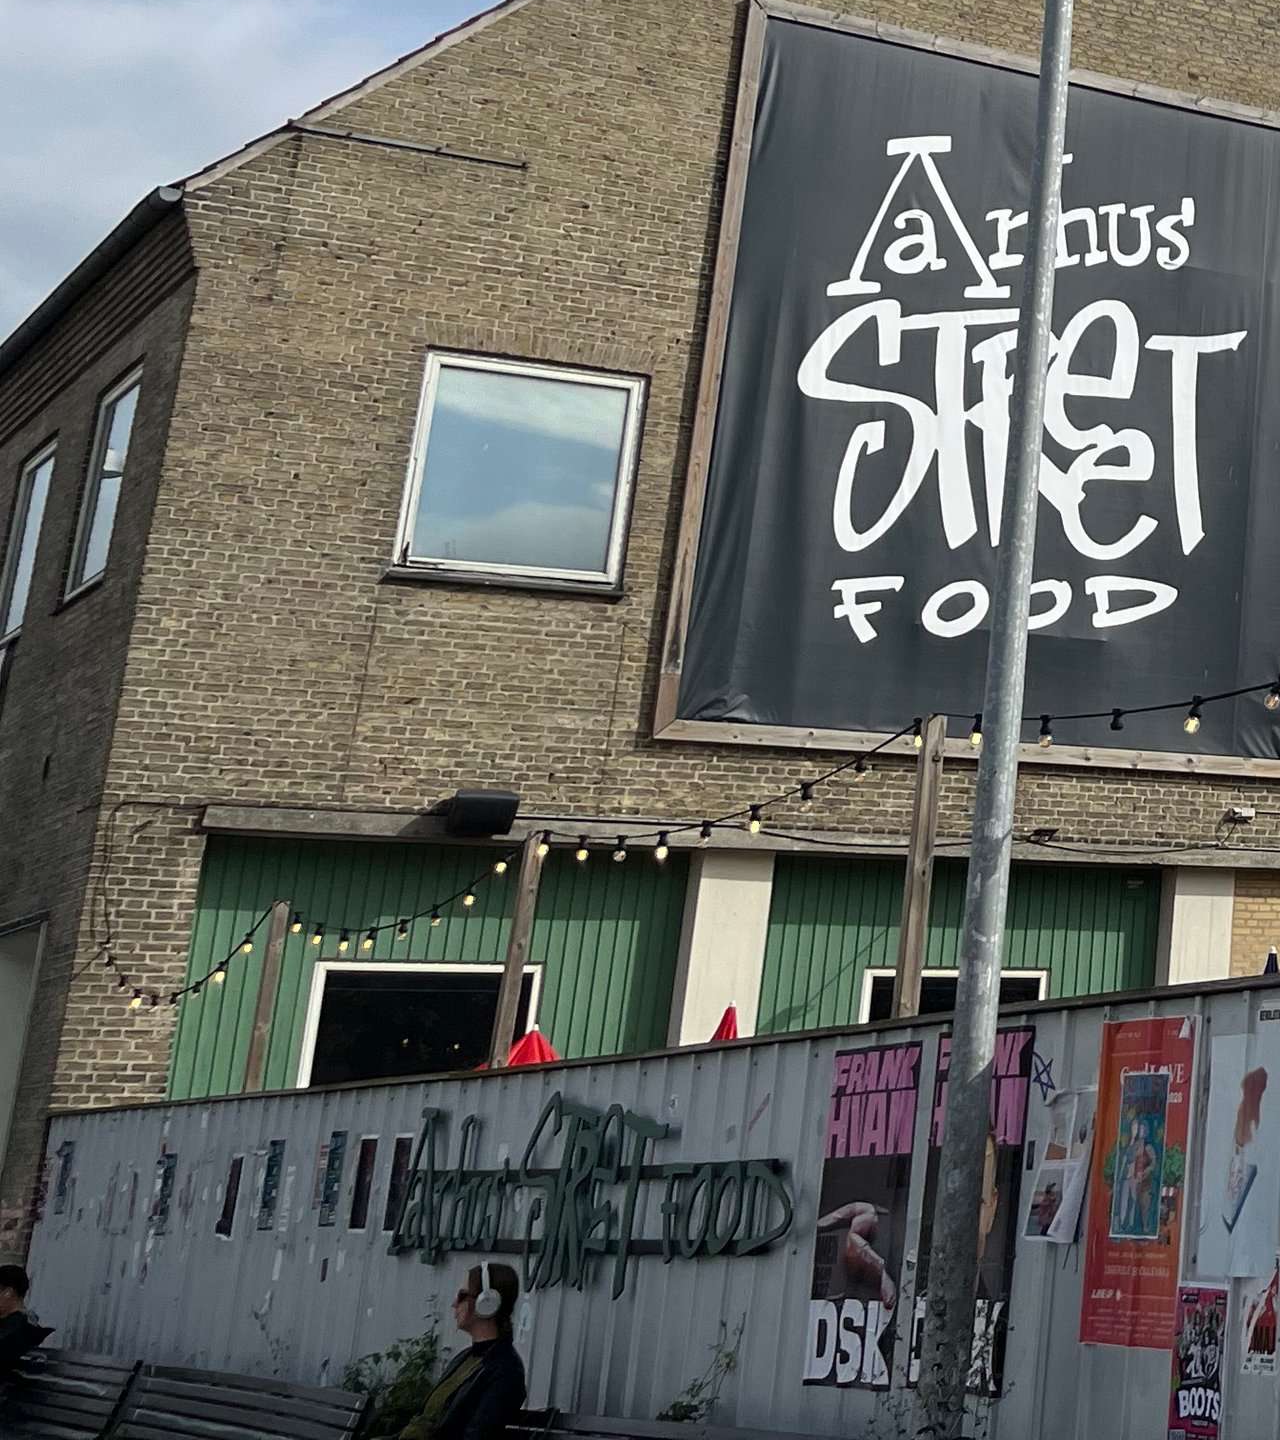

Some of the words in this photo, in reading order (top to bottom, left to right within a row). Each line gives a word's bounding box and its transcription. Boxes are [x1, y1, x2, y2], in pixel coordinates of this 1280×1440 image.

[831, 575, 1179, 644] FOOD
[832, 1047, 921, 1095] FRANK
[660, 1159, 793, 1264] FOOD
[803, 1298, 896, 1386] DSK
[1177, 1386, 1222, 1421] BOOTS
